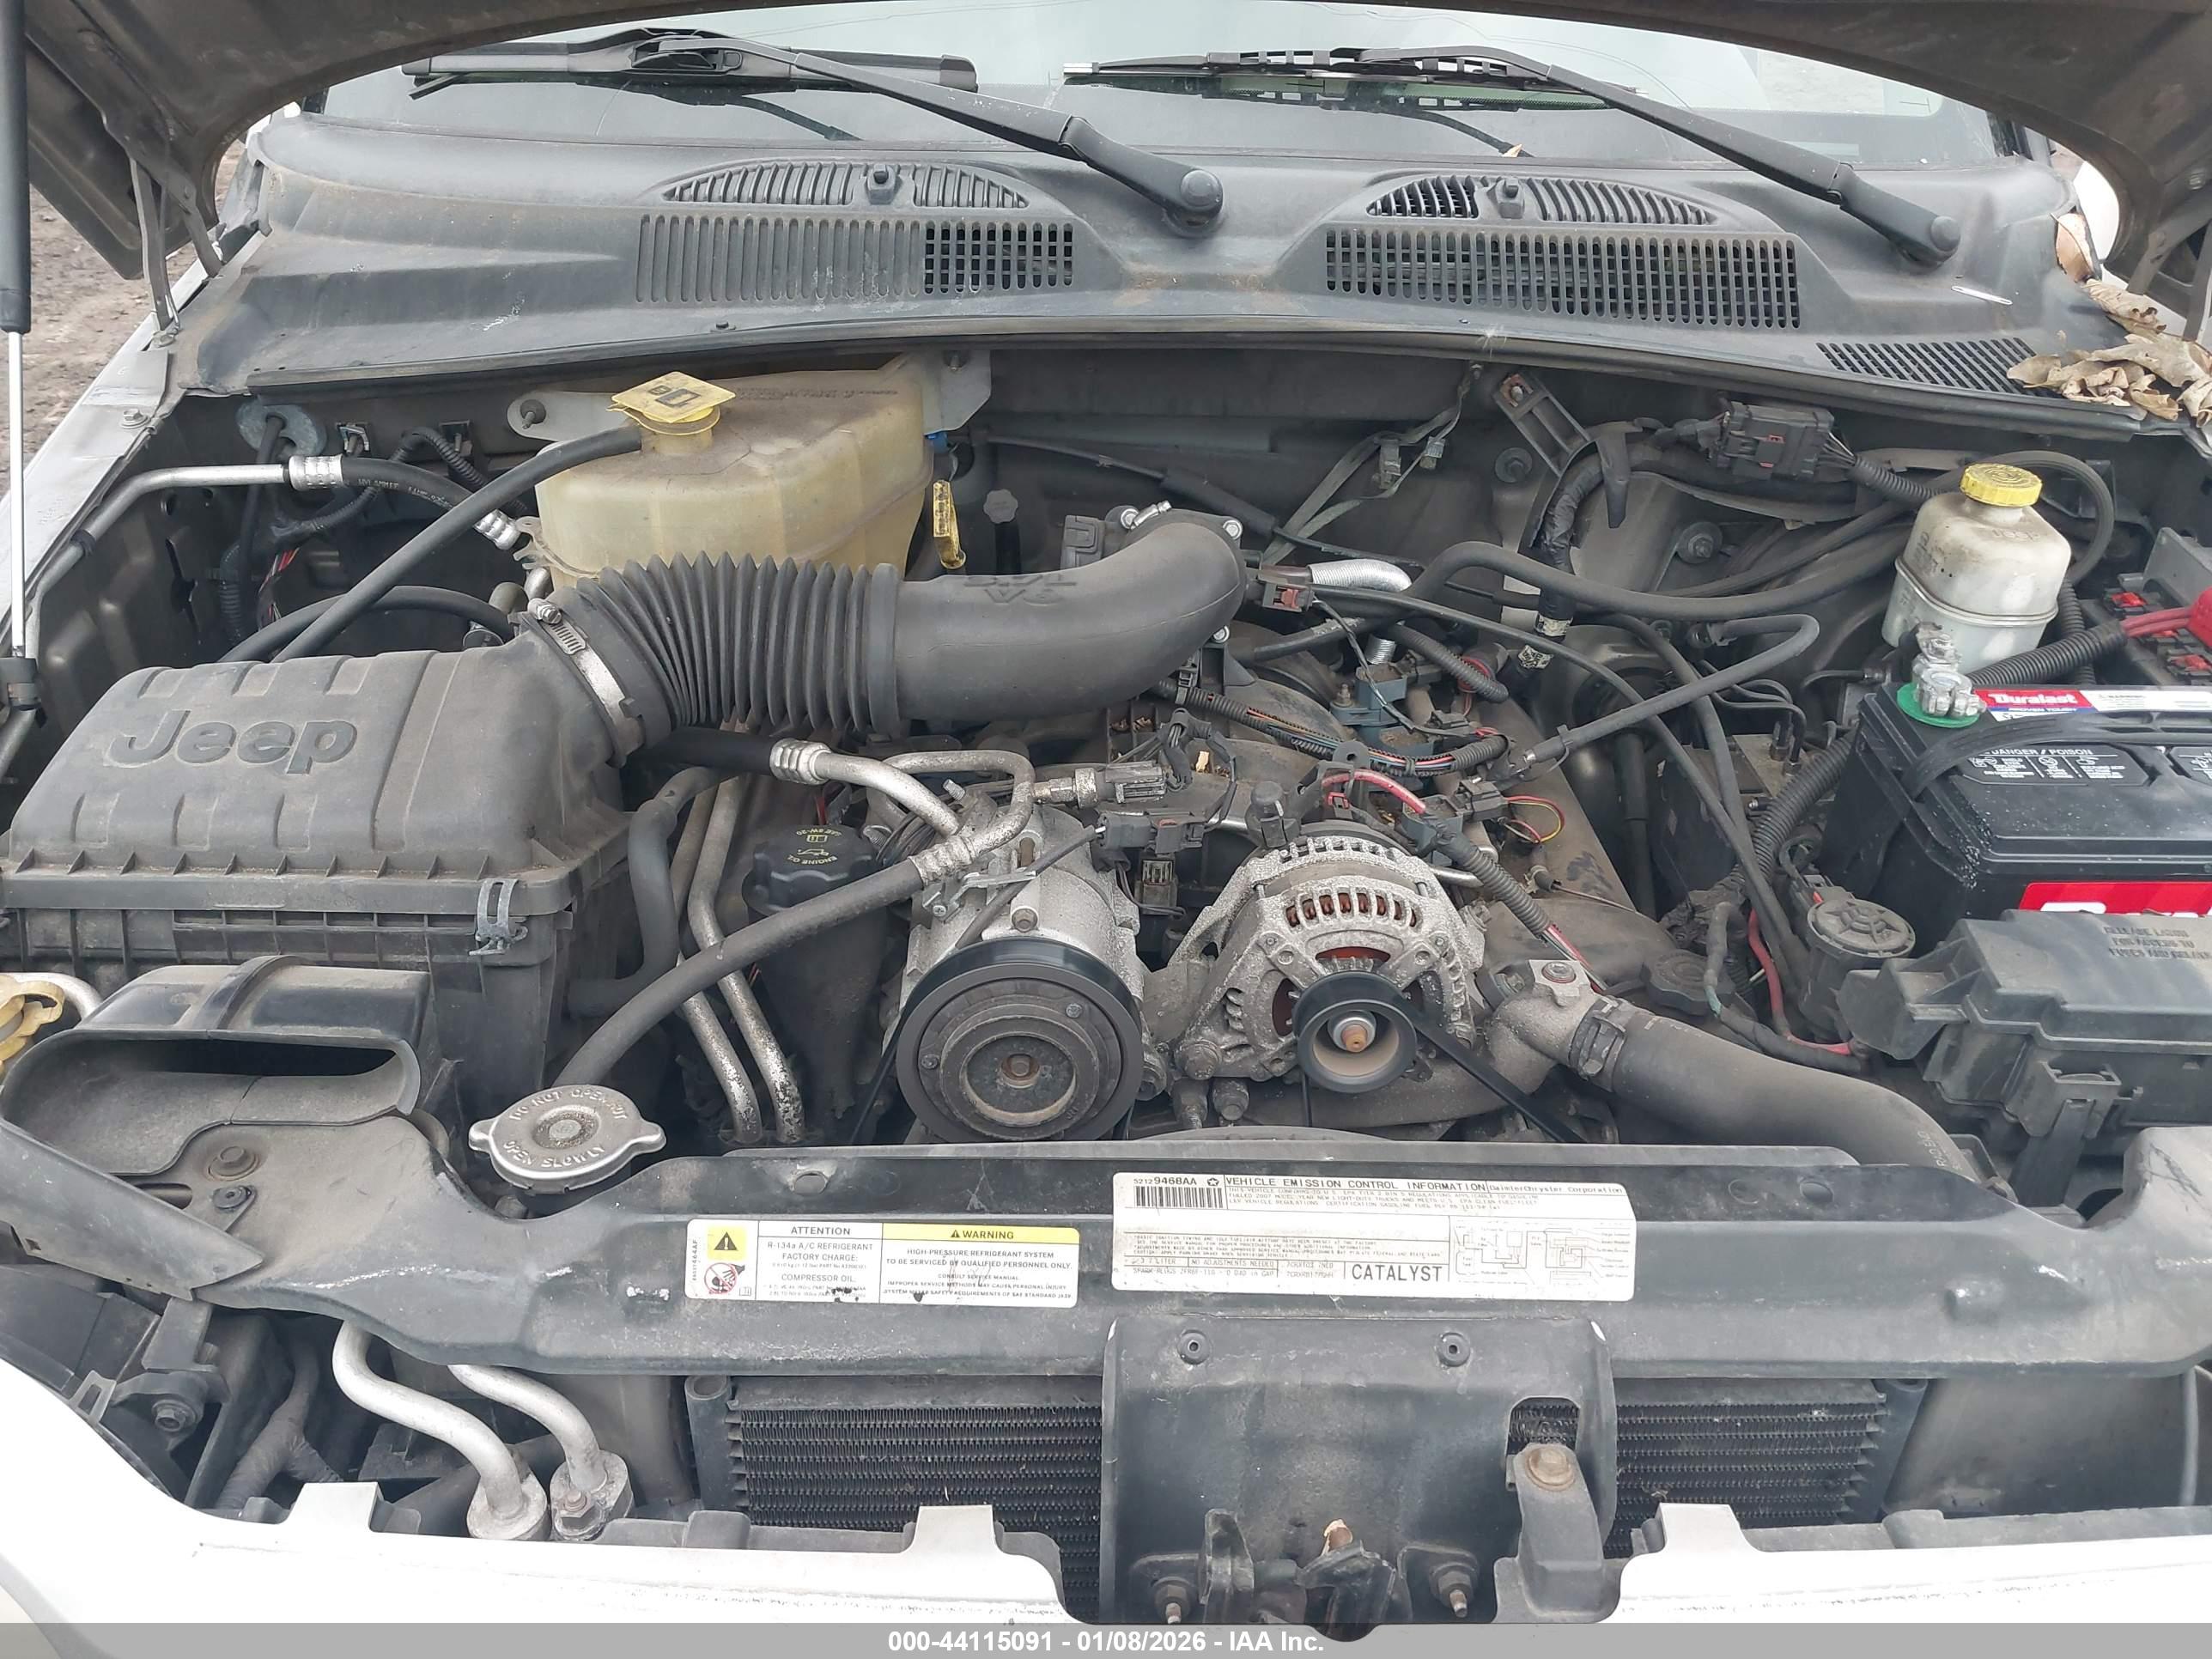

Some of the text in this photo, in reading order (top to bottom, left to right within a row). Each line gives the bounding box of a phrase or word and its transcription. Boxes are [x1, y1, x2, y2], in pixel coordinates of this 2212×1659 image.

[1988, 693, 2078, 704] Duralast
[100, 708, 358, 775] Jeep
[801, 855, 838, 866] ENGINE
[509, 1105, 529, 1121] DO
[532, 1091, 563, 1106] NOT
[541, 1146, 605, 1168] SLOWLY
[1226, 1177, 1486, 1192] VEHICLE EMISSION CONTROL INFORMATION
[790, 1226, 851, 1236] ATTENTION
[963, 1231, 1014, 1239] WARNING
[768, 1241, 796, 1249] R-134a
[817, 1243, 873, 1251] REFRIGERANT
[781, 1273, 839, 1282] COMPRESSOR
[1352, 1263, 1443, 1282] CATALYST
